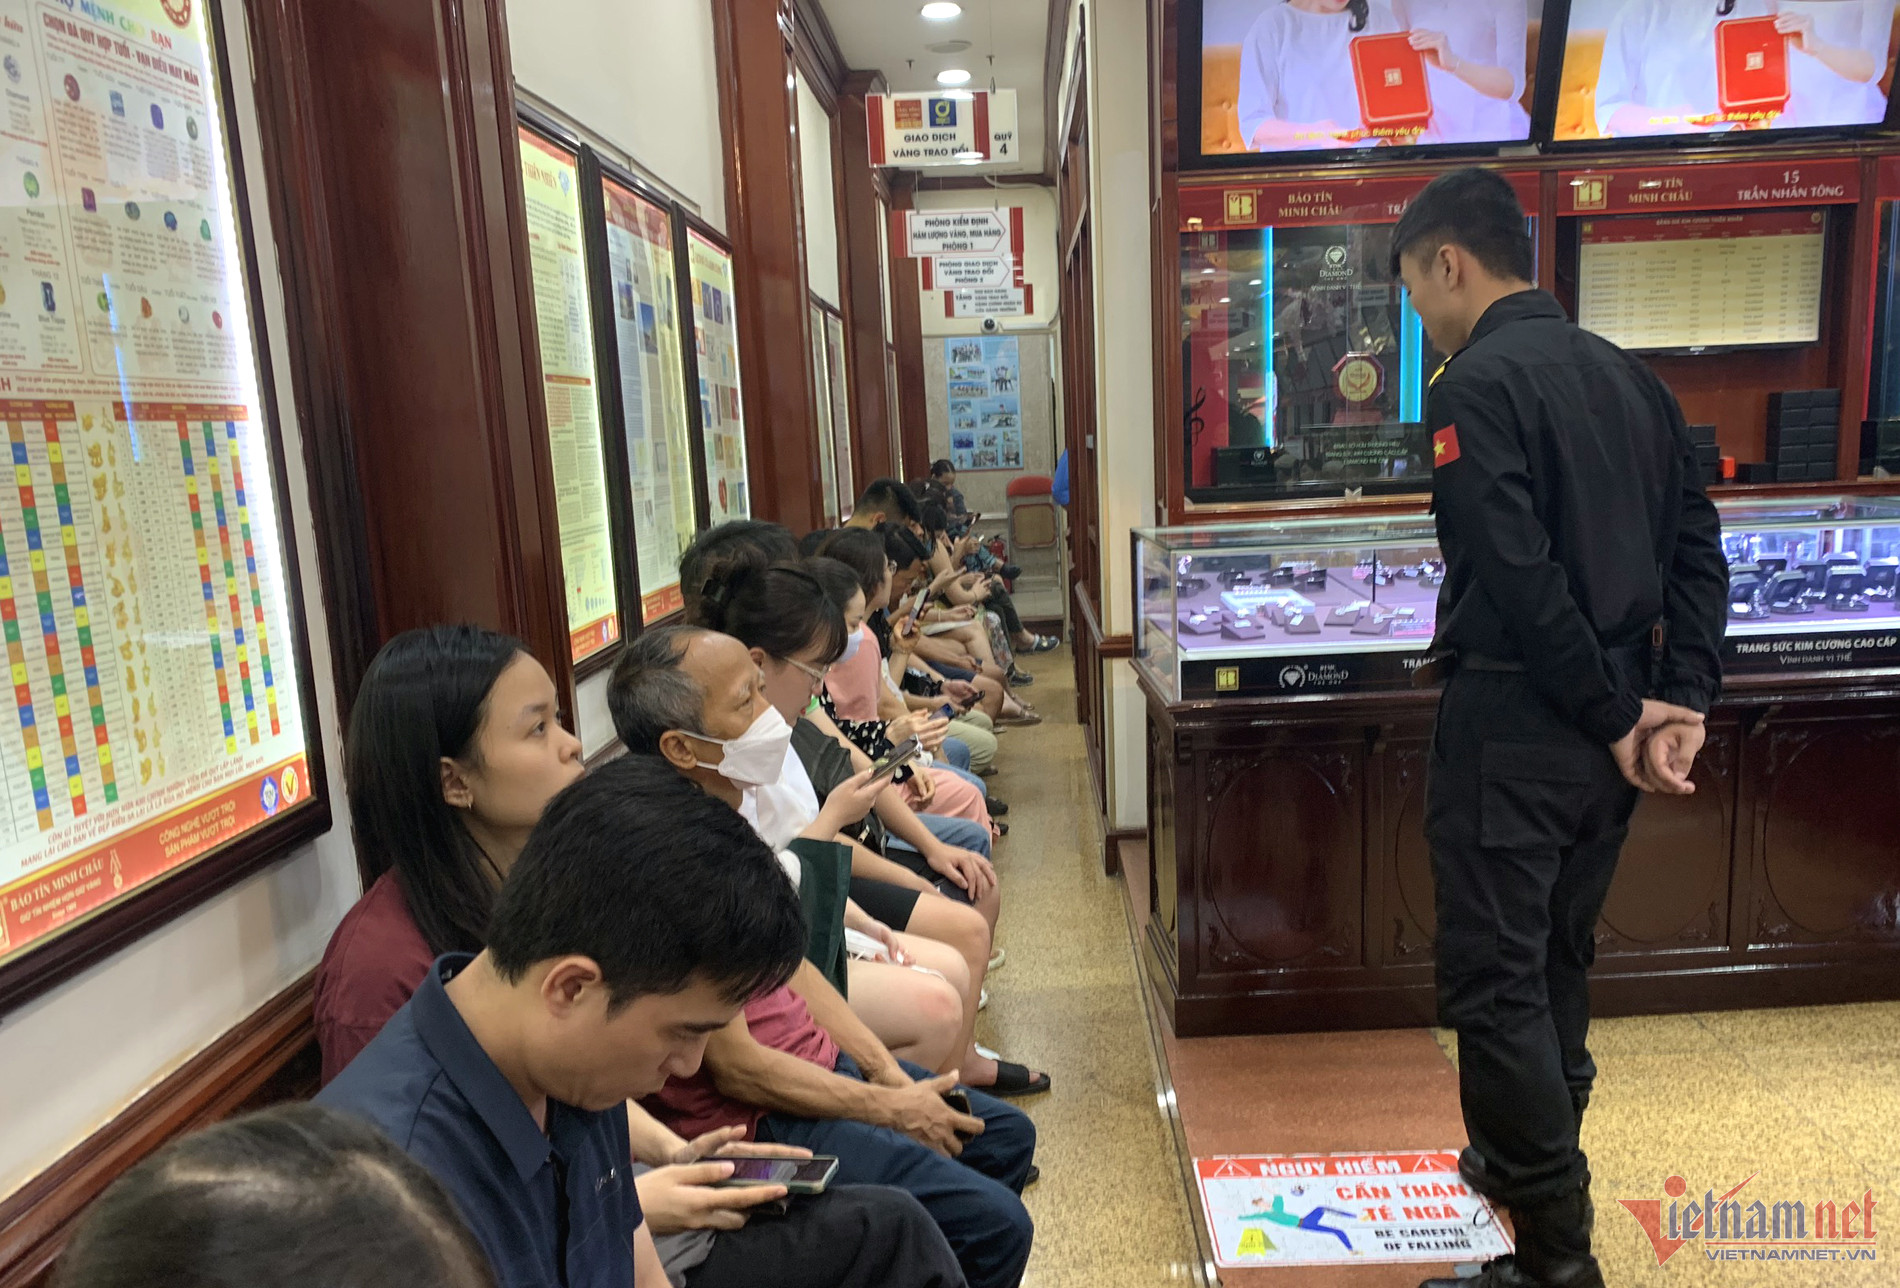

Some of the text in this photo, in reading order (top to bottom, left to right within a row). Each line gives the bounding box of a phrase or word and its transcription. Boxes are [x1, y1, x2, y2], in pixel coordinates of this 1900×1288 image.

[43, 12, 66, 34] CHỌN
[66, 21, 79, 38] ĐÁ
[112, 40, 130, 59] TUỔI
[119, 16, 145, 38] CHO
[150, 29, 172, 50] BẠN
[903, 132, 956, 144] GIAO DỊCH
[994, 131, 1012, 142] QUỸ
[892, 147, 920, 158] VÀNG
[923, 147, 948, 158] TRAO
[999, 143, 1008, 156] 4
[1664, 176, 1683, 189] TÍN
[1783, 170, 1800, 184] 15
[1288, 190, 1332, 204] BẢO TÍN
[1628, 189, 1693, 204] MINH CHÂU
[1737, 184, 1844, 200] TRẦN NHÂN TÔNG
[1278, 203, 1343, 218] MINH CHÂU
[925, 213, 989, 227] PHÒNG KIỂM ĐỊNH
[913, 229, 926, 240] HÀM
[928, 229, 949, 240] LƯỢNG
[969, 229, 983, 238] MUA
[984, 227, 1001, 237] HÀNG
[942, 241, 974, 251] PHÒNG 1
[1735, 635, 1897, 654] TRANG SỨC KIM CƯƠNG CAO CẤP
[1802, 654, 1824, 664] DANH
[1836, 651, 1852, 662] THẾ
[1308, 669, 1349, 682] DIAMOND
[158, 799, 236, 846] CÔNG NGHỆ VƯỢT TRỘI
[200, 823, 220, 842] VƯỢT
[220, 815, 236, 832] TRỘI
[20, 850, 43, 867] MANG
[57, 840, 71, 852] CHO
[10, 857, 104, 912] BẢO TÍN MINH CHÂU
[1259, 1157, 1400, 1177] NGUY HIỂM
[1336, 1180, 1468, 1201] CẨN THẬN
[1363, 1203, 1461, 1222] TÉ NGÃ
[1375, 1227, 1468, 1239] BE CAREFUL
[1384, 1240, 1472, 1252] OF FALLING
